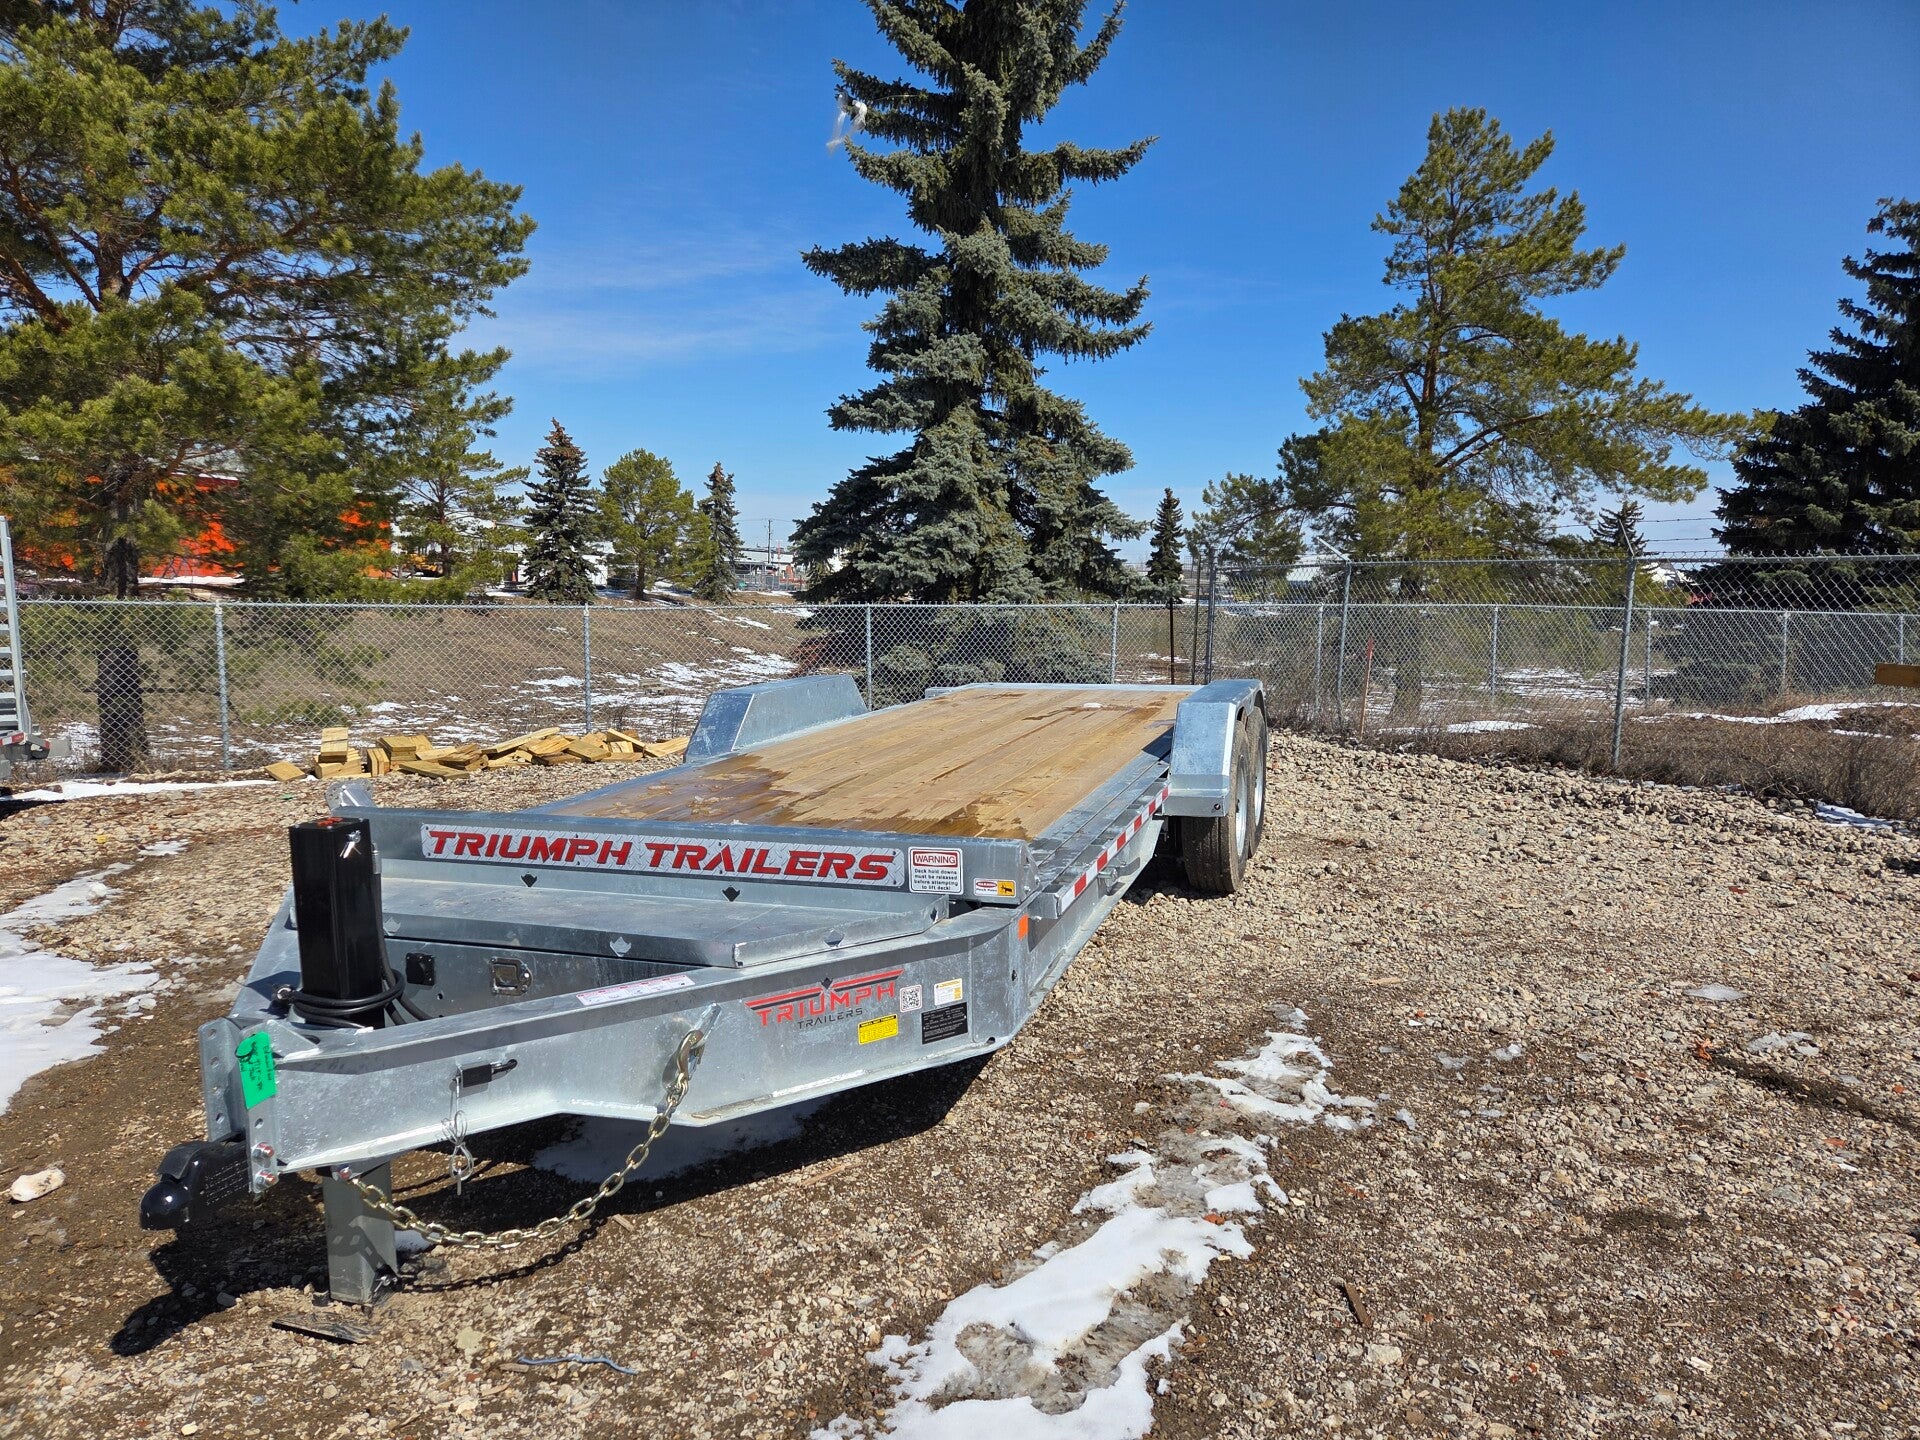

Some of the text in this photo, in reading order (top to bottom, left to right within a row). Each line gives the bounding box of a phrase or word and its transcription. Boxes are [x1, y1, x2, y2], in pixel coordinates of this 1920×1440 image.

[428, 830, 895, 881] TRIUMPH TRAILERS
[915, 855, 956, 864] WARNING
[756, 981, 896, 1027] TRIUMPH
[797, 1007, 863, 1030] TRAILERS
